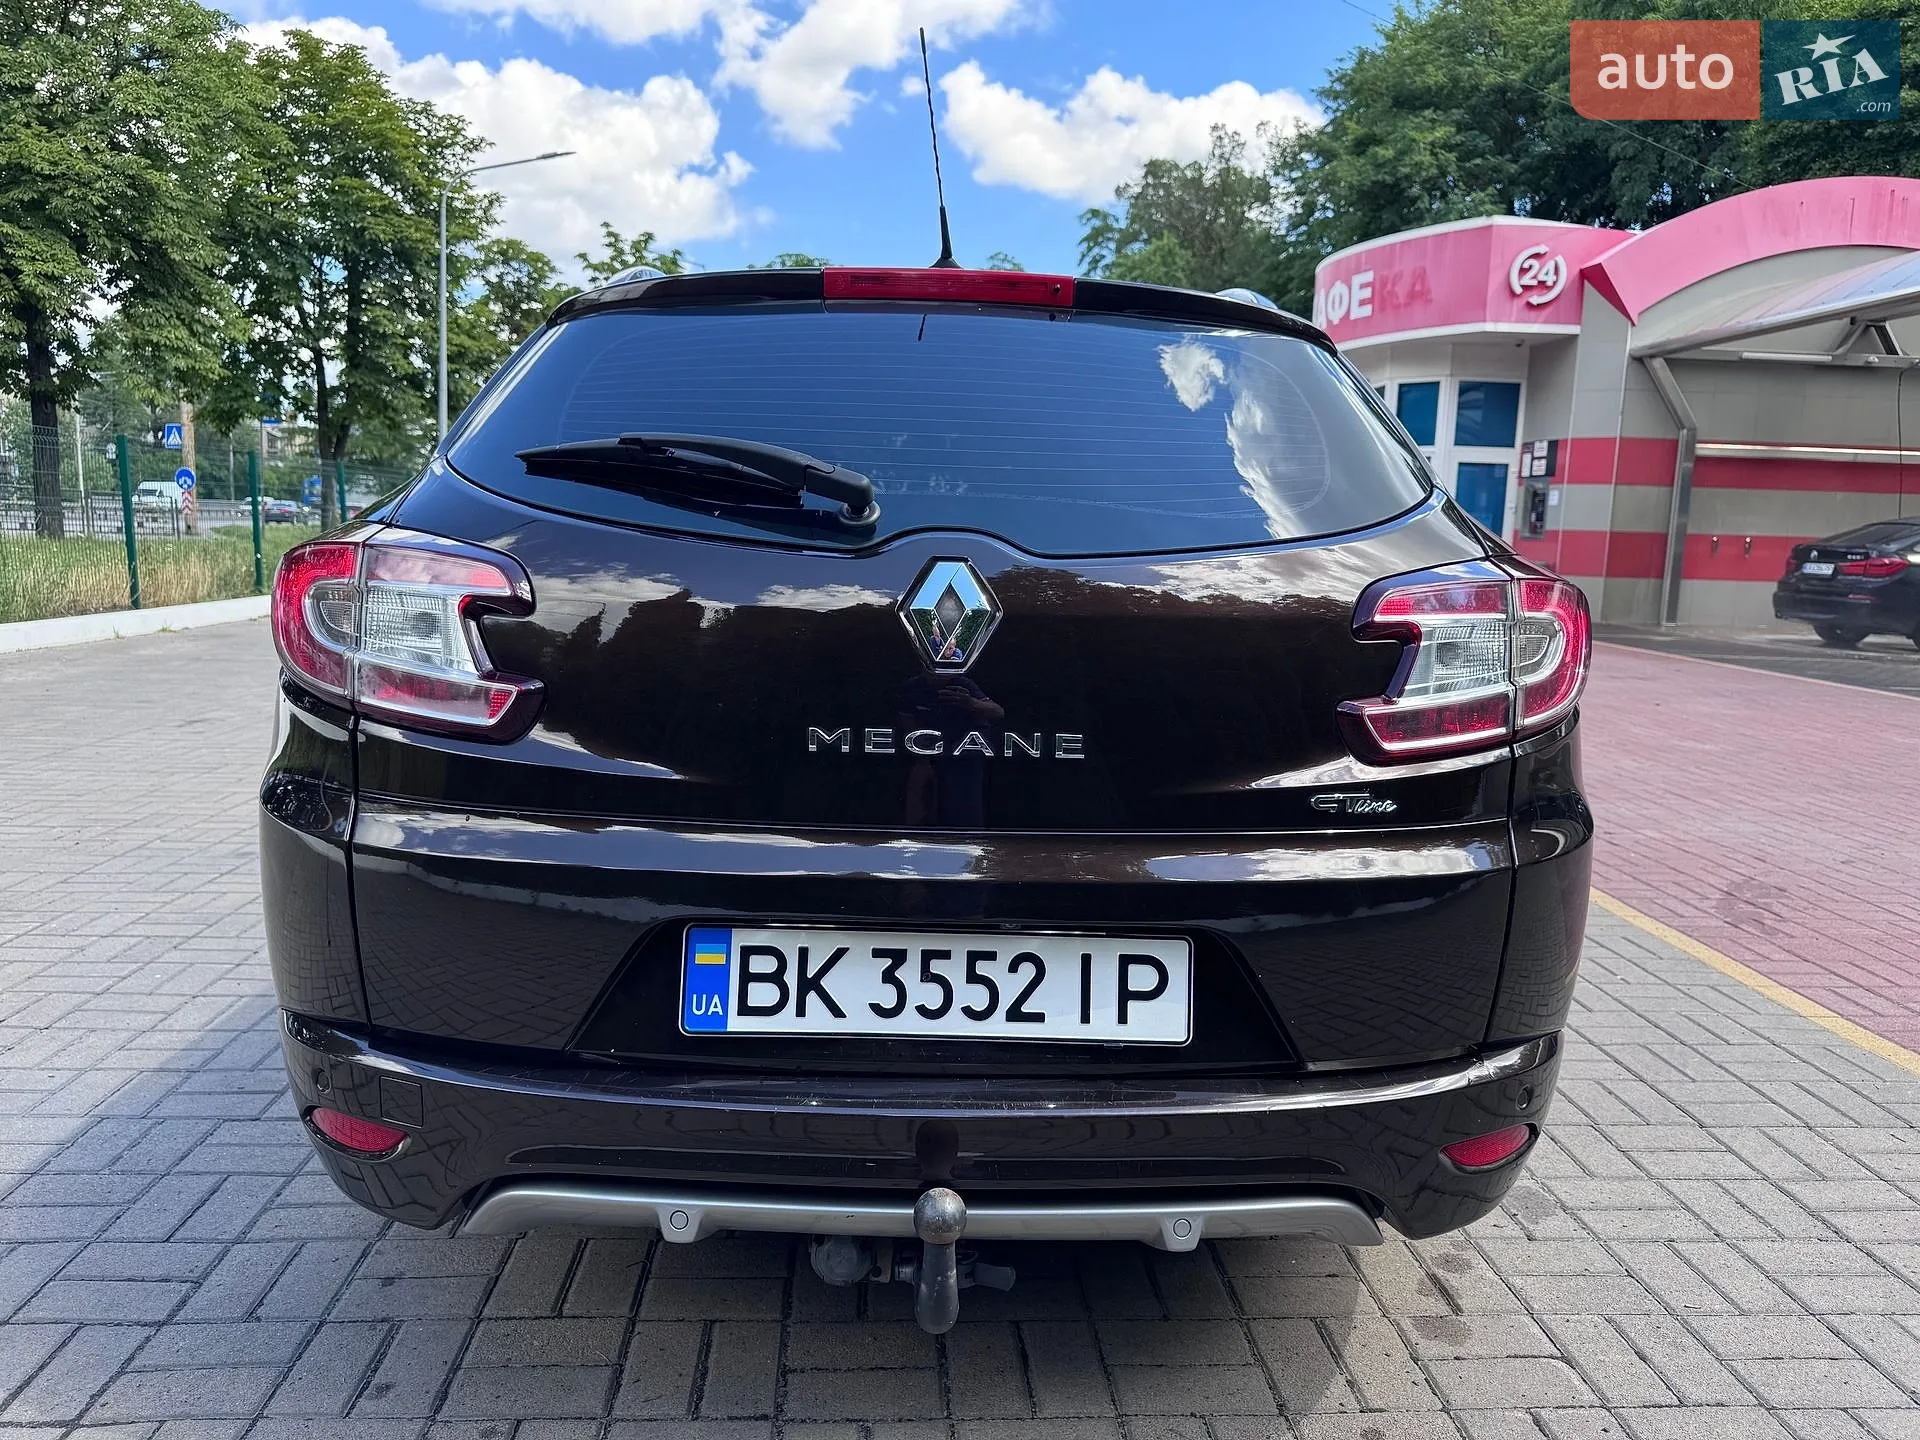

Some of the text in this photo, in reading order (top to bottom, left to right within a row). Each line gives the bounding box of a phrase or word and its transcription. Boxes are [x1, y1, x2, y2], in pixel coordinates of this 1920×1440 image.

[1520, 259, 1557, 286] 24
[807, 727, 1085, 759] MEGANE
[736, 945, 1170, 1025] BK 3552 IP
[692, 994, 724, 1016] UA
